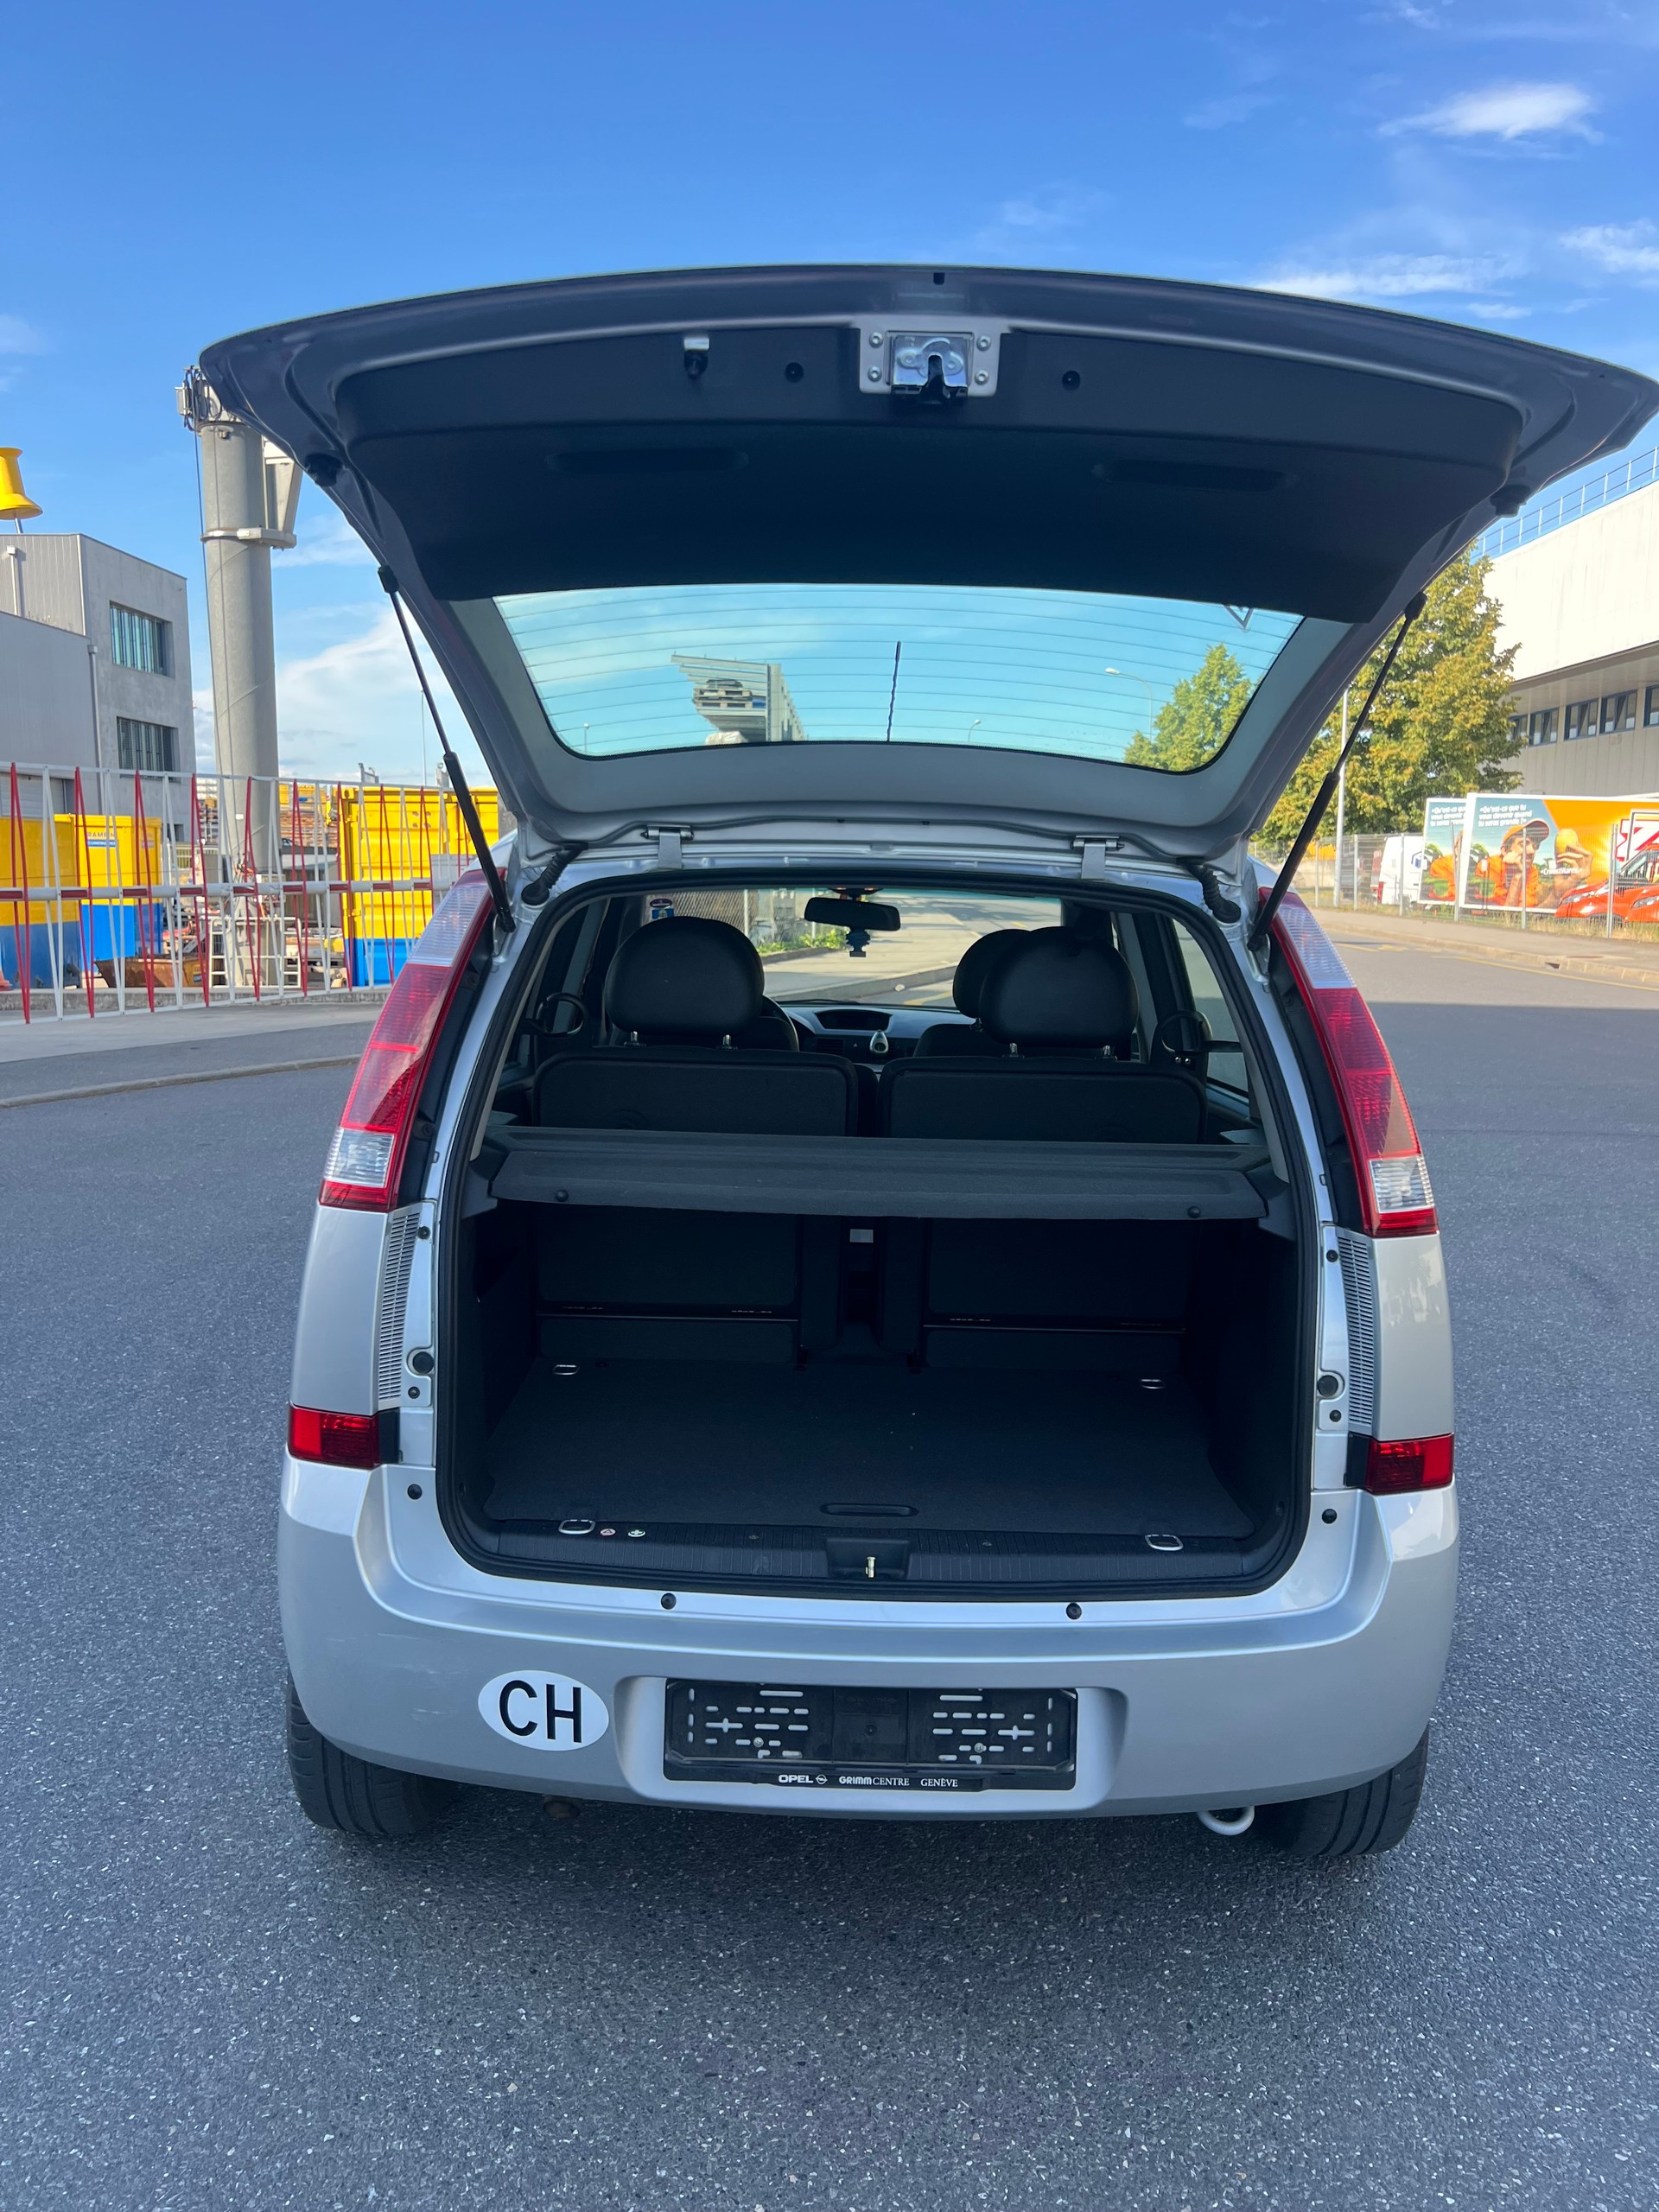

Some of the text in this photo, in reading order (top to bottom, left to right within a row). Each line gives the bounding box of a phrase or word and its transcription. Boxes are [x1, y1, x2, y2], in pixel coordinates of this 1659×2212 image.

[499, 1680, 582, 1744] CH
[778, 1774, 814, 1783] OPEL
[920, 1777, 958, 1788] GENÈVE
